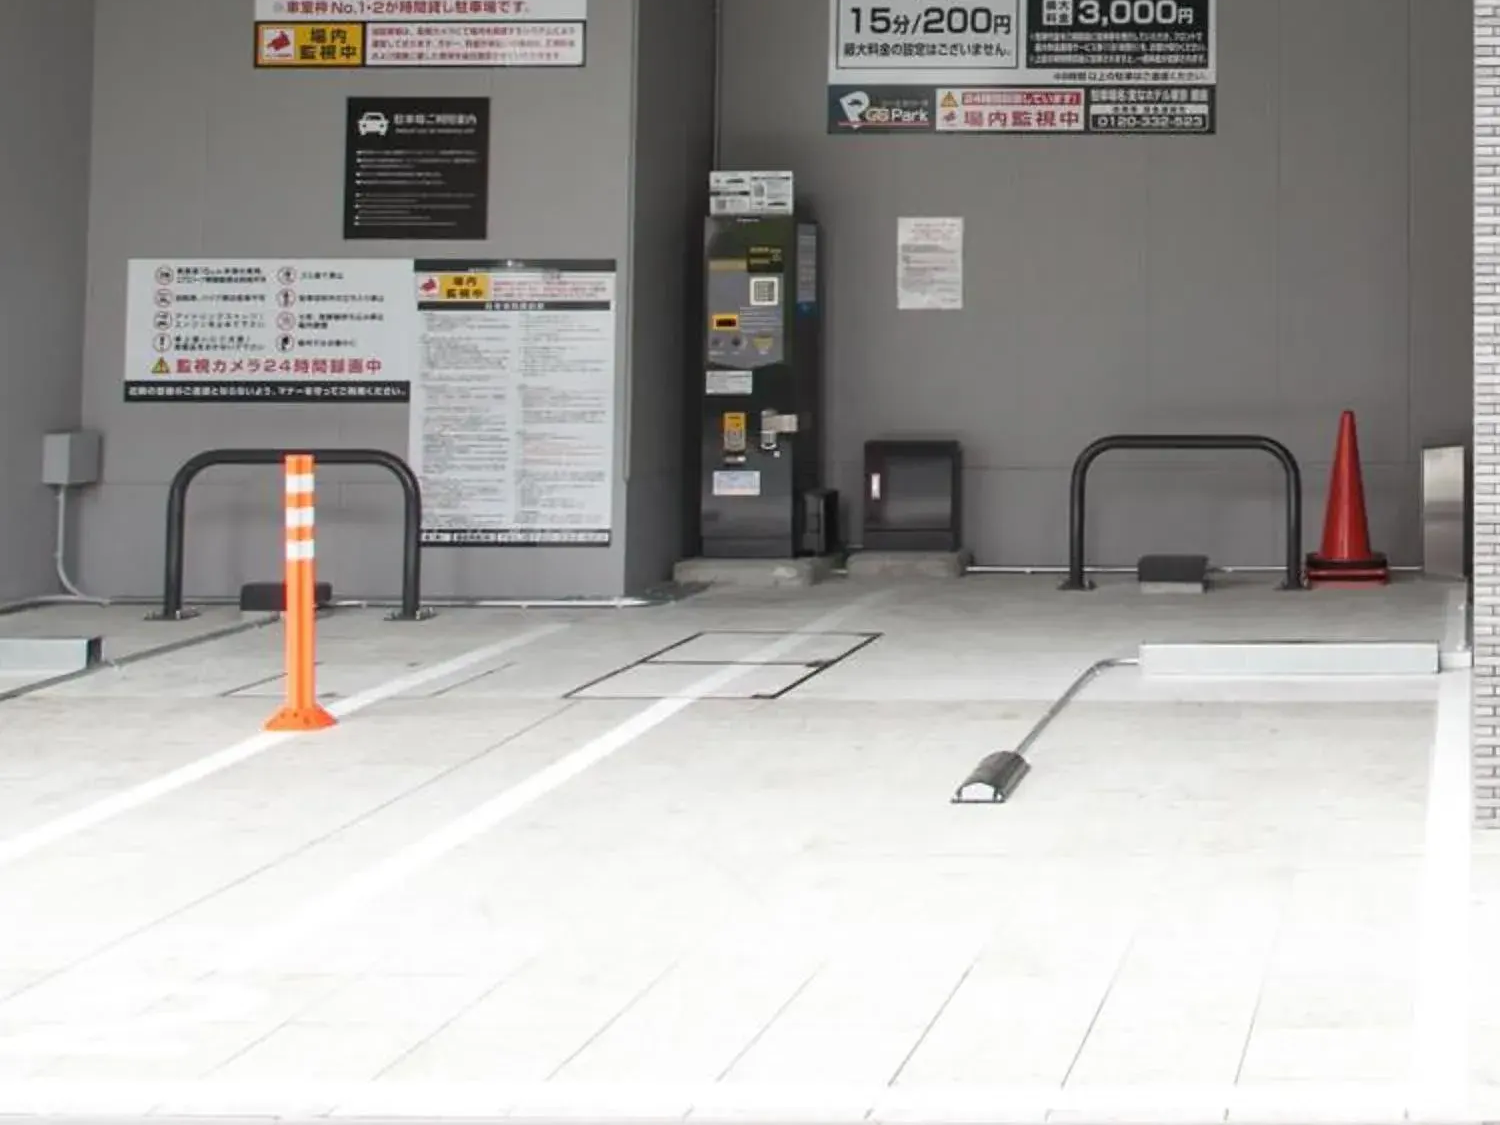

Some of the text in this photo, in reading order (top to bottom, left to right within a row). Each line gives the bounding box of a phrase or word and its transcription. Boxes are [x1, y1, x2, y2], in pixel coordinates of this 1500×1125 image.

[851, 6, 1011, 35] 15分/200円
[1078, 0, 1194, 26] 3,000円
[311, 27, 347, 43] 場内
[300, 45, 357, 60] 監視中
[963, 111, 1079, 127] 場内監視中
[176, 358, 382, 375] 監視カメラ24時間録画中
